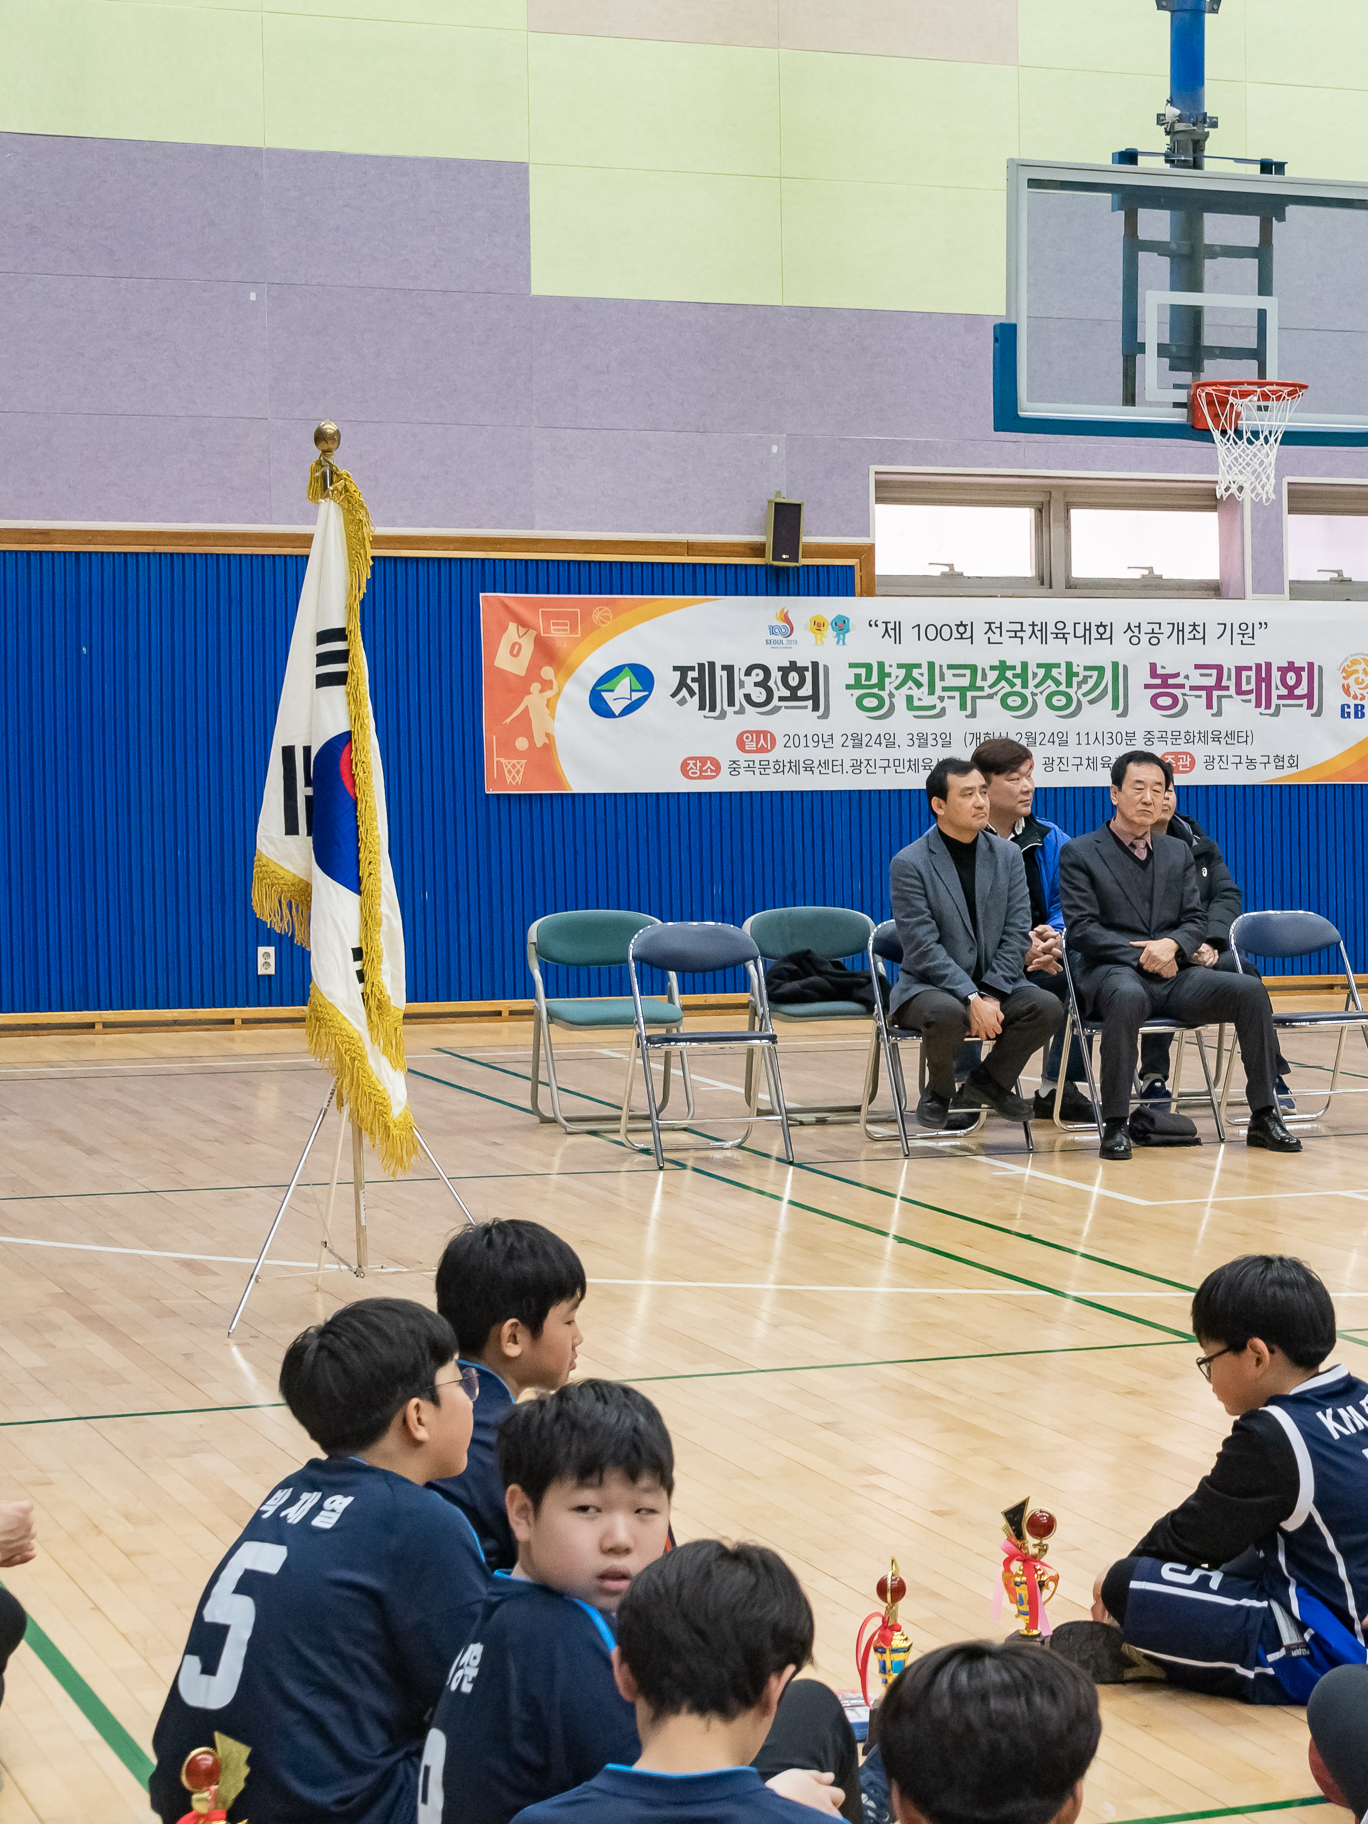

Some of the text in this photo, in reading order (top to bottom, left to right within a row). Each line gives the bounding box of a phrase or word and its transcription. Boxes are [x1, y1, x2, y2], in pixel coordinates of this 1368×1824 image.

[911, 620, 974, 645] 100회
[983, 620, 1113, 646] 전국체육대회
[1122, 621, 1207, 646] 성공개최
[669, 659, 1316, 714] 제13회 광진구청장기 농구대회
[742, 733, 772, 750] 일시
[783, 732, 835, 749] 2019년
[840, 732, 901, 749] 2월24일,
[906, 731, 952, 748] 3월3일
[1015, 731, 1069, 748] 2월24일
[1075, 730, 1137, 747] 11시30분
[686, 759, 717, 777] 장소
[1041, 755, 1117, 773] 광진구체육
[1202, 753, 1300, 771] 광진구농구협회
[178, 1540, 288, 1711] 5
